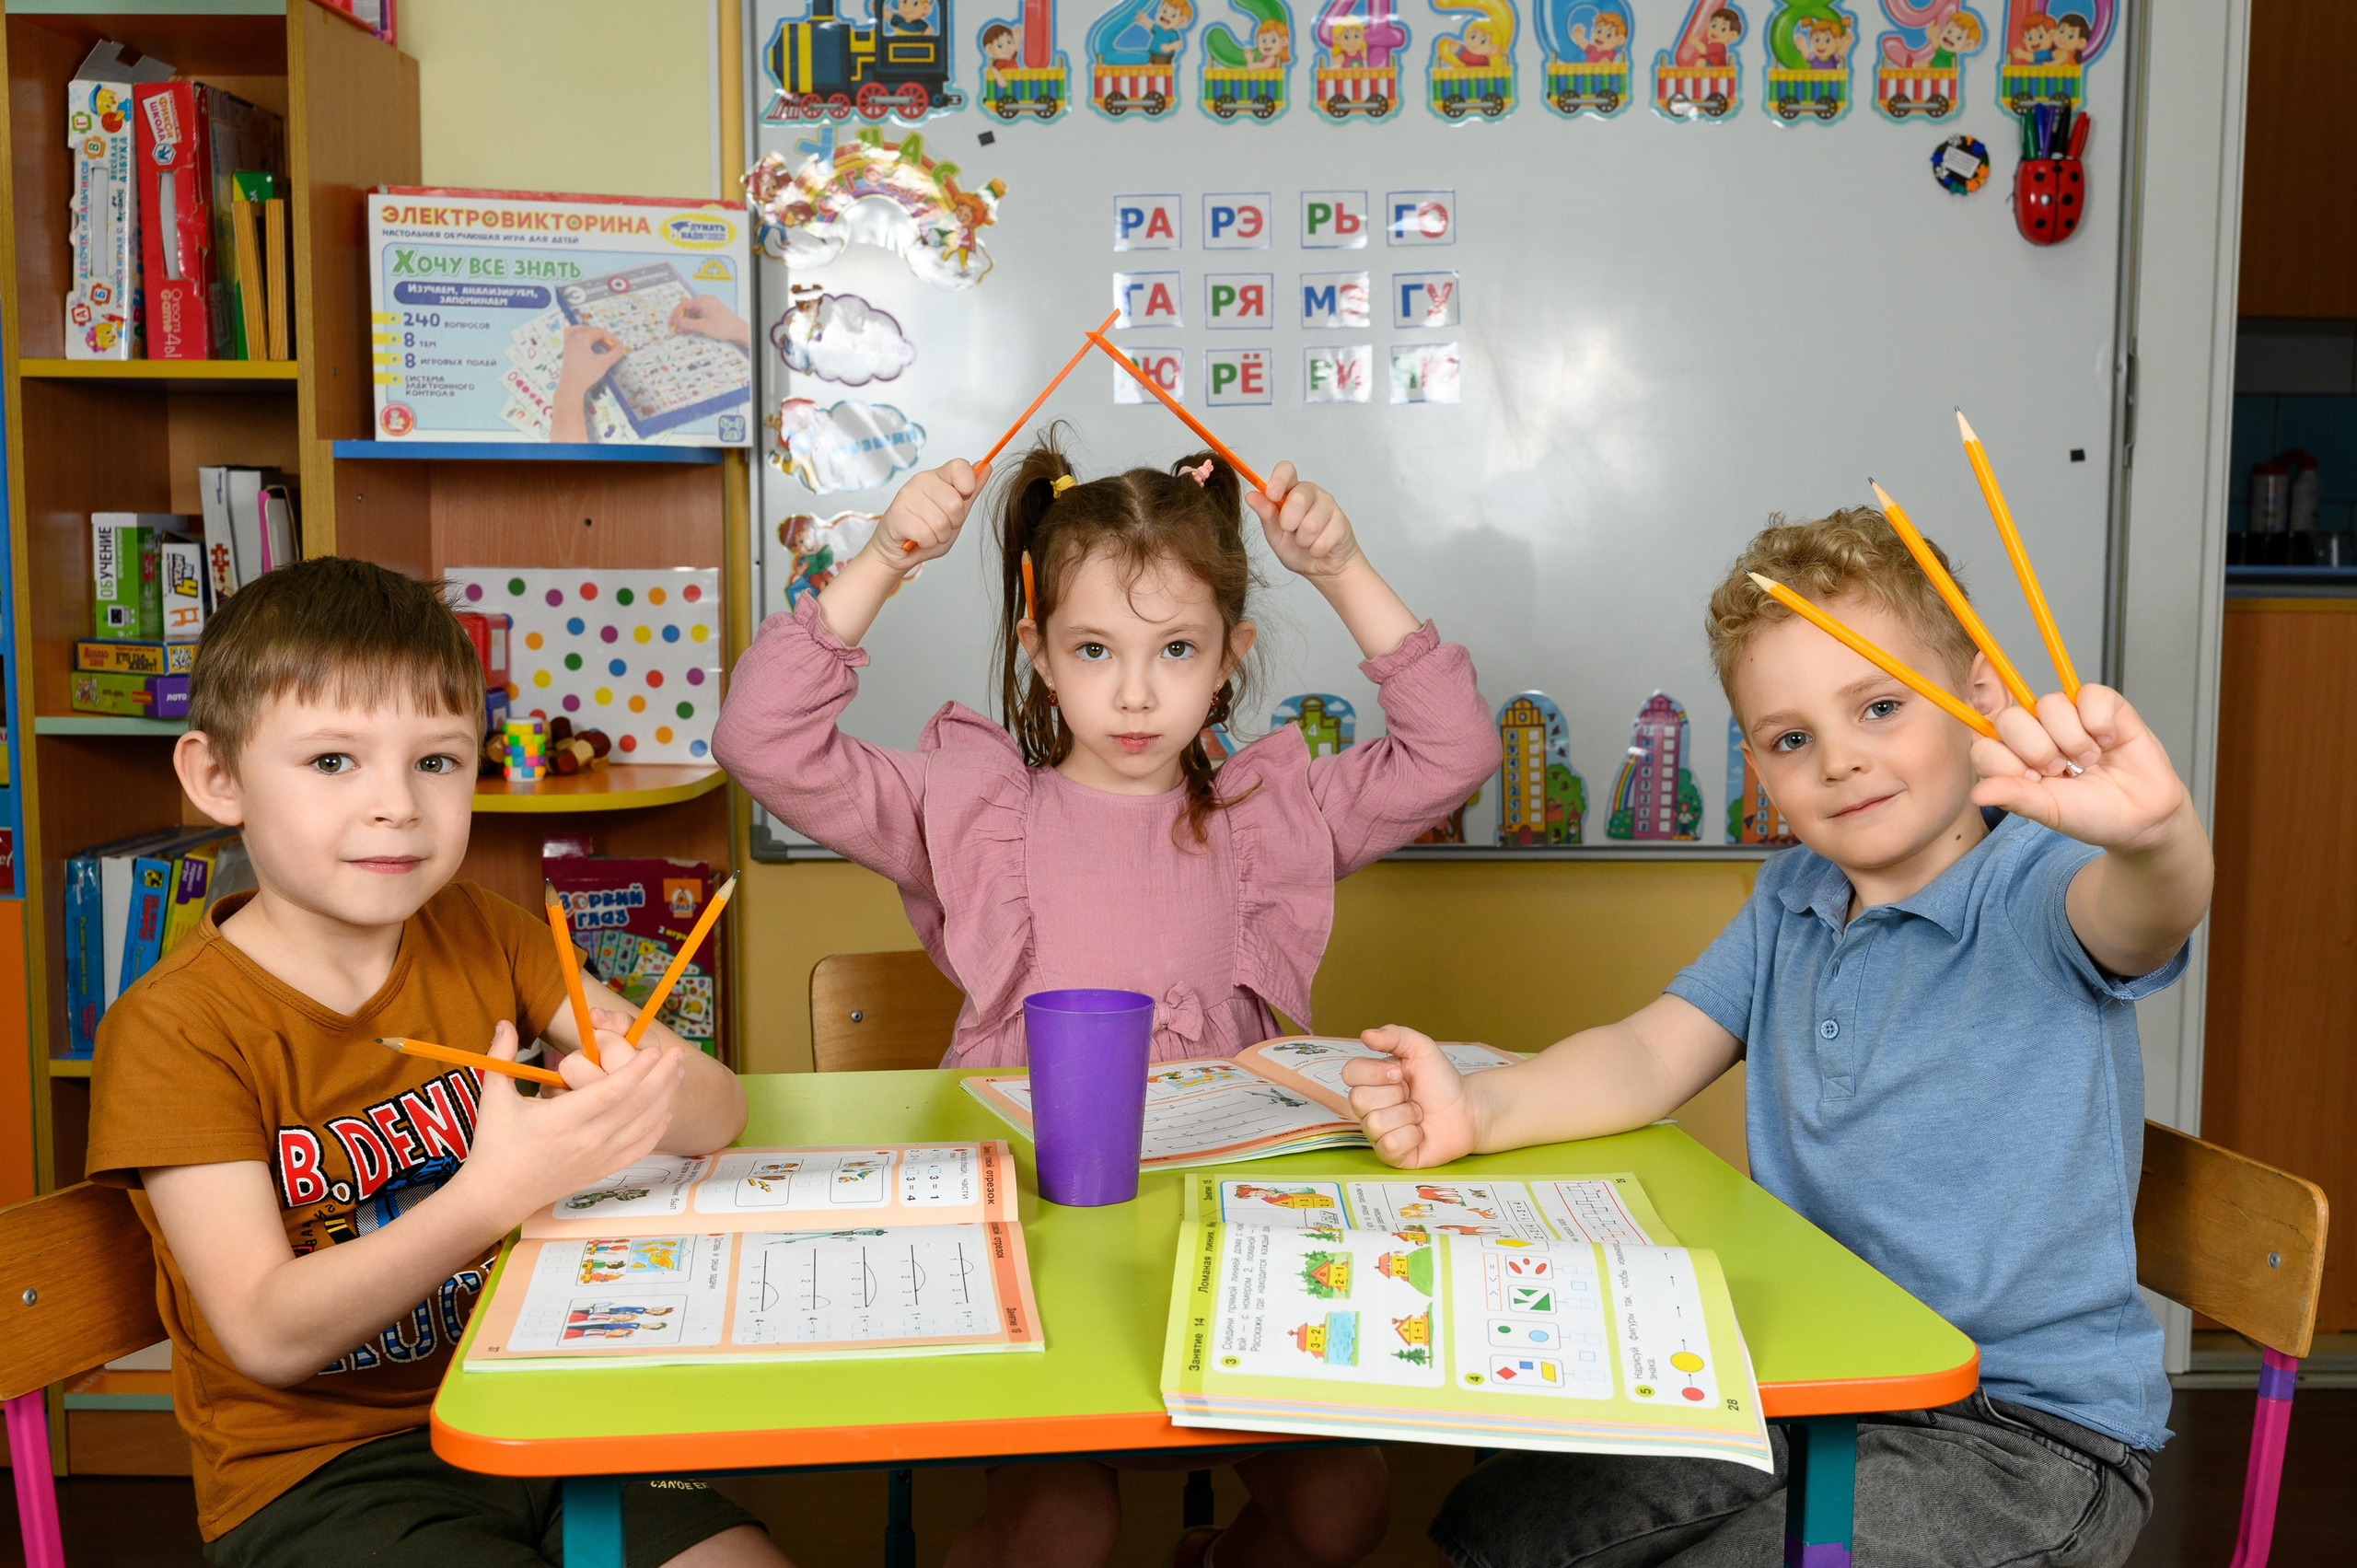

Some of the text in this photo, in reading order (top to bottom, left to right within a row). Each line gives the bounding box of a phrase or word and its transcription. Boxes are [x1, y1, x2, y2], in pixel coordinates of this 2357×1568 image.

[149, 101, 166, 142] ШКОЛА
[158, 97, 174, 139] ФИКСИ
[87, 143, 99, 152] В
[119, 136, 127, 183] АЗБУКА
[381, 204, 652, 235] ЭЛЕКТРОВИКТОРИНА
[1120, 206, 1174, 239] РА
[1212, 205, 1263, 238] РЭ
[1307, 203, 1360, 235] РЬ
[1394, 203, 1448, 238] ГО
[382, 228, 579, 244] НАСТОЛЬНАЯ ОБУЧАЮЩАЯ ИГРА ДЛЯ ДЕТЕЙ
[392, 249, 581, 278] ХОЧУ ВСЕ ЗНАТЬ
[94, 289, 106, 299] Б
[408, 284, 539, 299] ИЗУЧАЕМ, АНАЛИЗИРУЕМ,
[439, 296, 507, 307] ЗАПОМИНАЕМ
[1121, 283, 1176, 317] ГА
[1212, 285, 1264, 317] РЯ
[1402, 282, 1453, 318] ГУ
[75, 309, 87, 319] А
[402, 312, 491, 330] 240 ВОПРОСОВ
[403, 331, 415, 348] 8
[404, 353, 497, 368] 8 ИГРОВЫХ ПОЛЕЙ
[1212, 353, 1263, 394] РЁ
[404, 375, 445, 383] СИСТЕМА
[99, 526, 113, 598] ОБУЧЕНИЕ
[1307, 723, 1318, 737] 4
[278, 1066, 485, 1207] B.DENI
[985, 1169, 995, 1205] отрезок
[993, 1236, 1004, 1259] отрезок
[1205, 1229, 1215, 1252] линия.
[1234, 1237, 1243, 1255] дома
[1247, 1236, 1256, 1262] ломаной
[1198, 1256, 1213, 1294] Ломаная
[1231, 1257, 1240, 1283] линией
[1243, 1266, 1255, 1277] 2,
[1619, 1270, 1630, 1288] чтобы
[1227, 1283, 1238, 1314] прямой
[1242, 1278, 1252, 1310] номером
[1250, 1232, 1271, 1353] Расскажи, где находится каждый
[1222, 1316, 1235, 1351] Соедини
[1628, 1313, 1640, 1341] фигуры
[1189, 1318, 1205, 1372] Занятие 14
[1237, 1339, 1248, 1352] вой
[1225, 1357, 1237, 1365] 3
[1630, 1347, 1644, 1380] Нарисуй
[1649, 1357, 1658, 1381] знака.
[1469, 1375, 1480, 1383] 4
[1726, 1399, 1739, 1411] 28
[650, 1480, 693, 1491] CANOE
